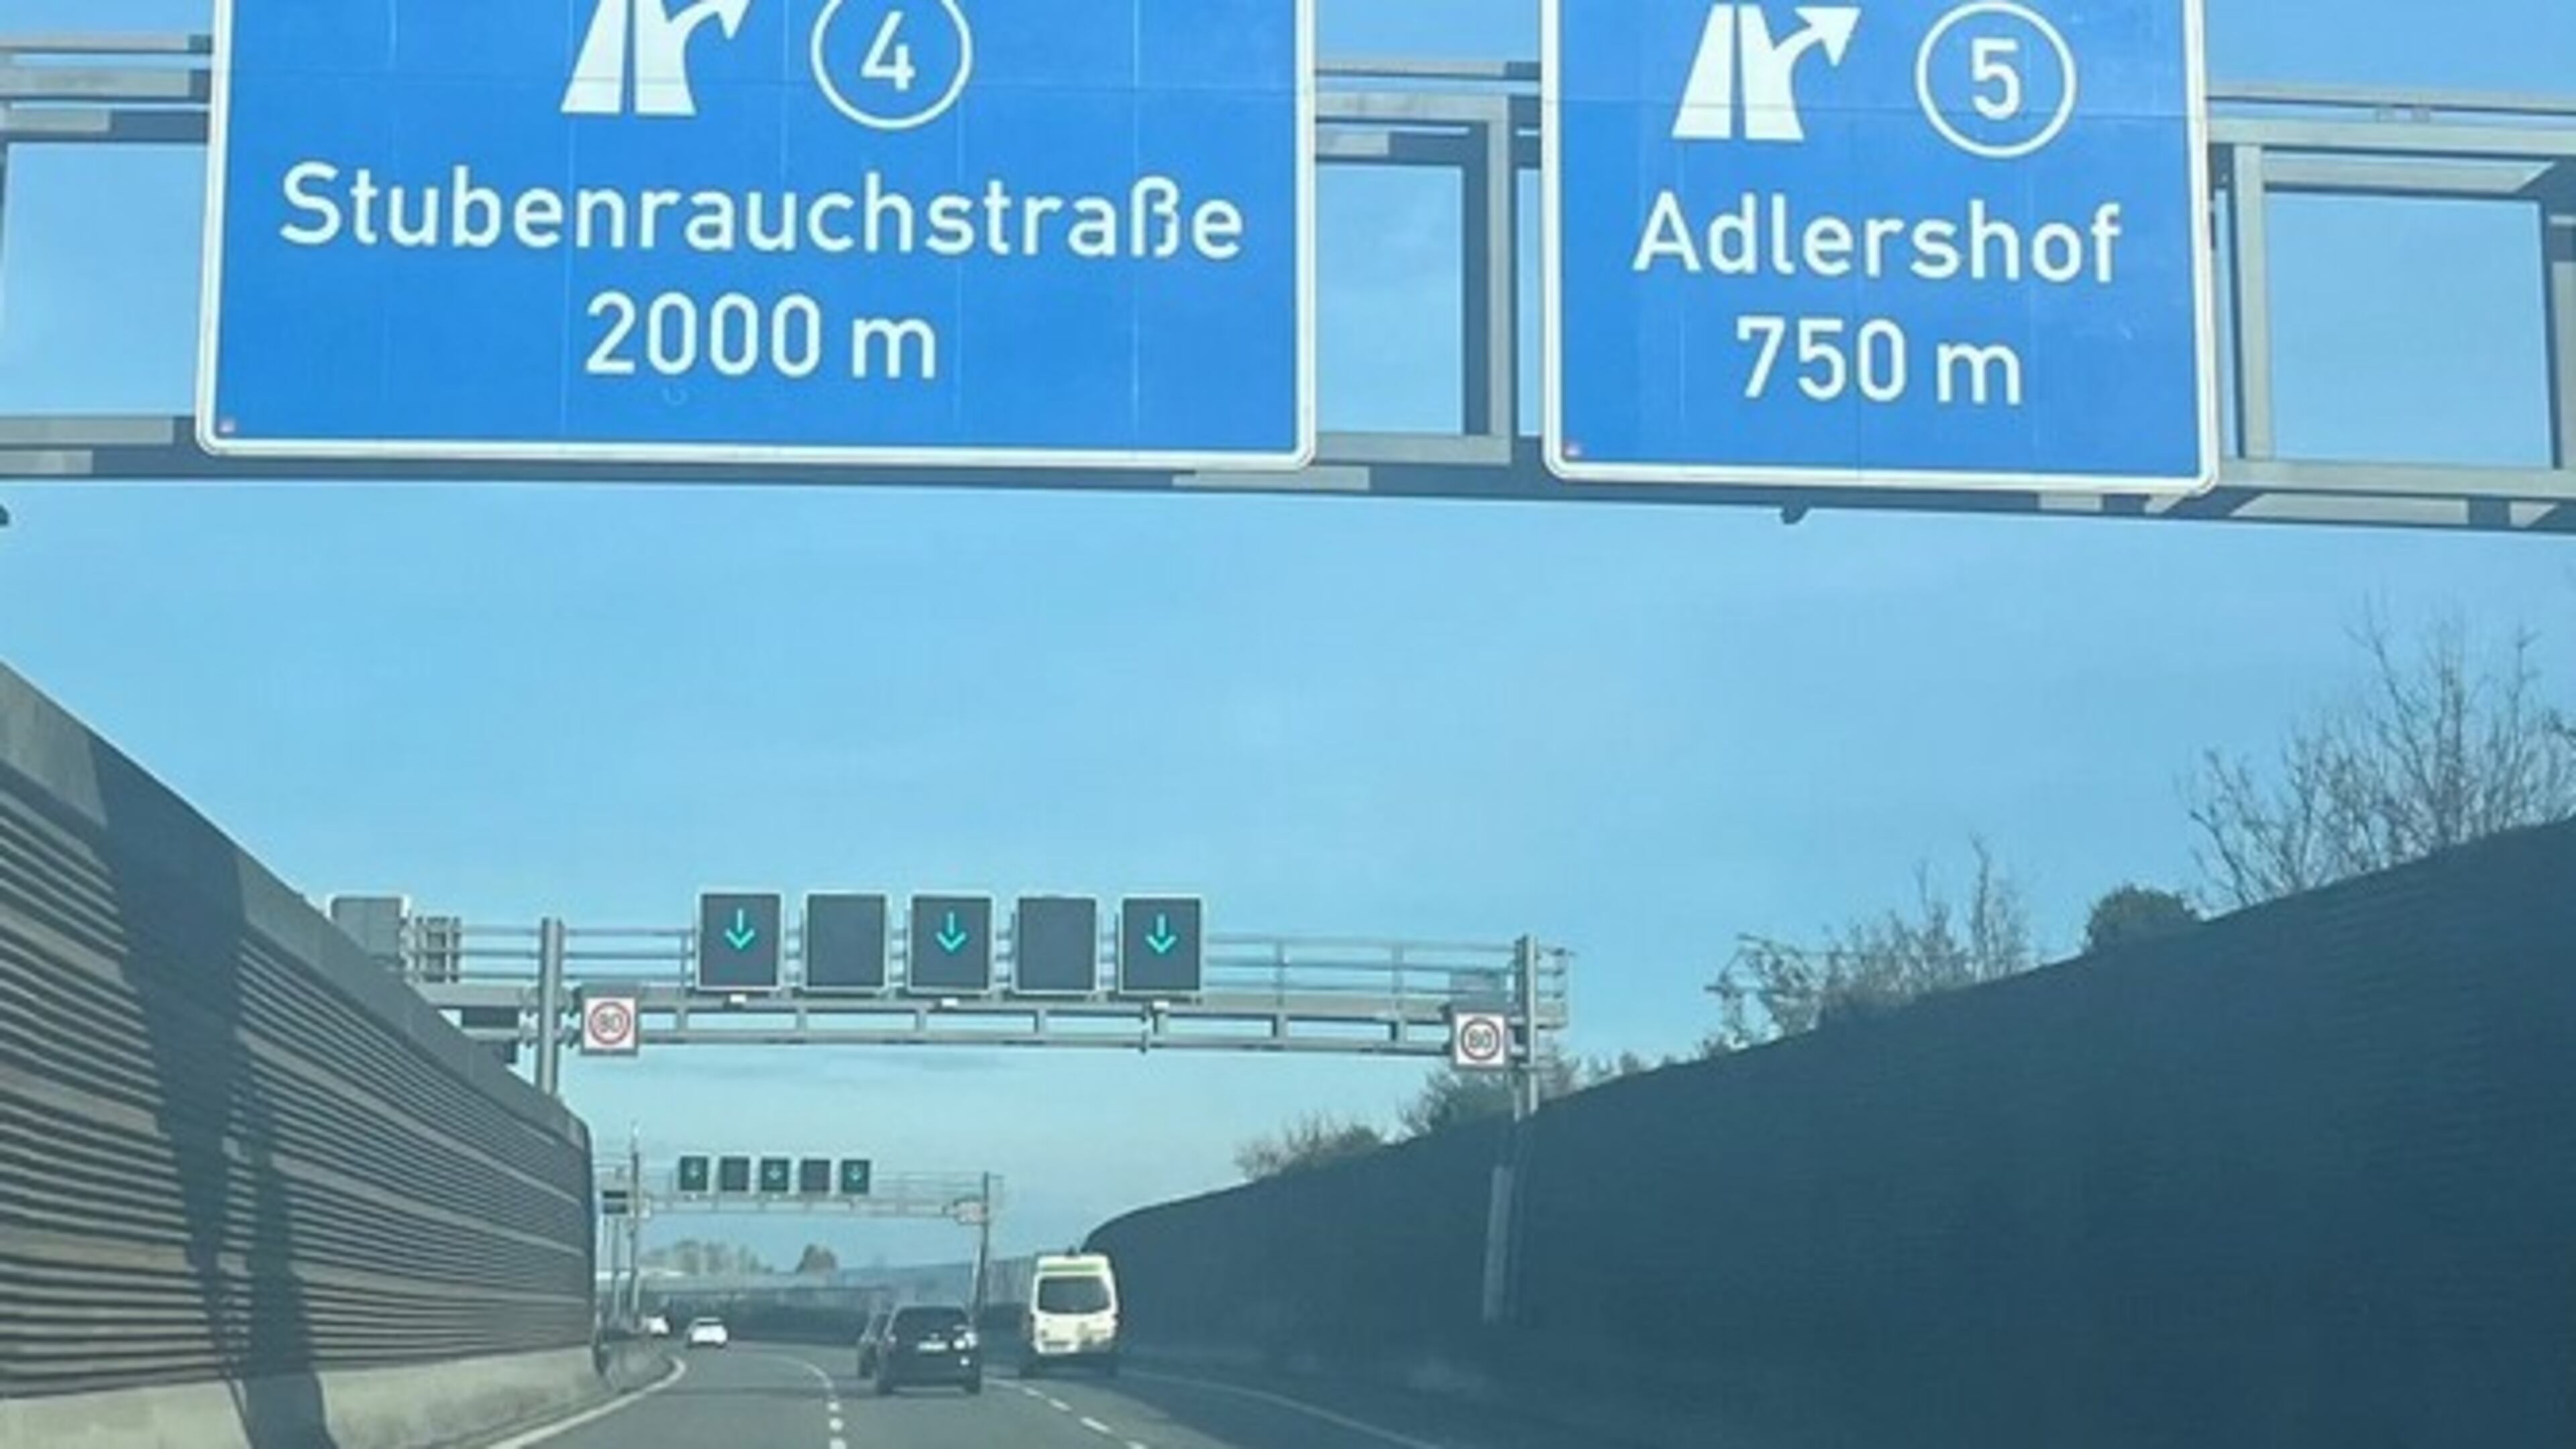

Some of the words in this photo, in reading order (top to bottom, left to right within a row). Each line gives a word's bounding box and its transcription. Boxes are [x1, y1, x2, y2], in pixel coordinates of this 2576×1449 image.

[863, 12, 915, 90] 4
[1972, 37, 2022, 119] 5
[281, 161, 1243, 260] Stubenrauchstraße
[1633, 191, 2122, 283] Adlershof
[586, 291, 820, 378] 2000
[852, 319, 936, 379] m
[1737, 315, 1907, 402] 750
[1937, 344, 2021, 406] m
